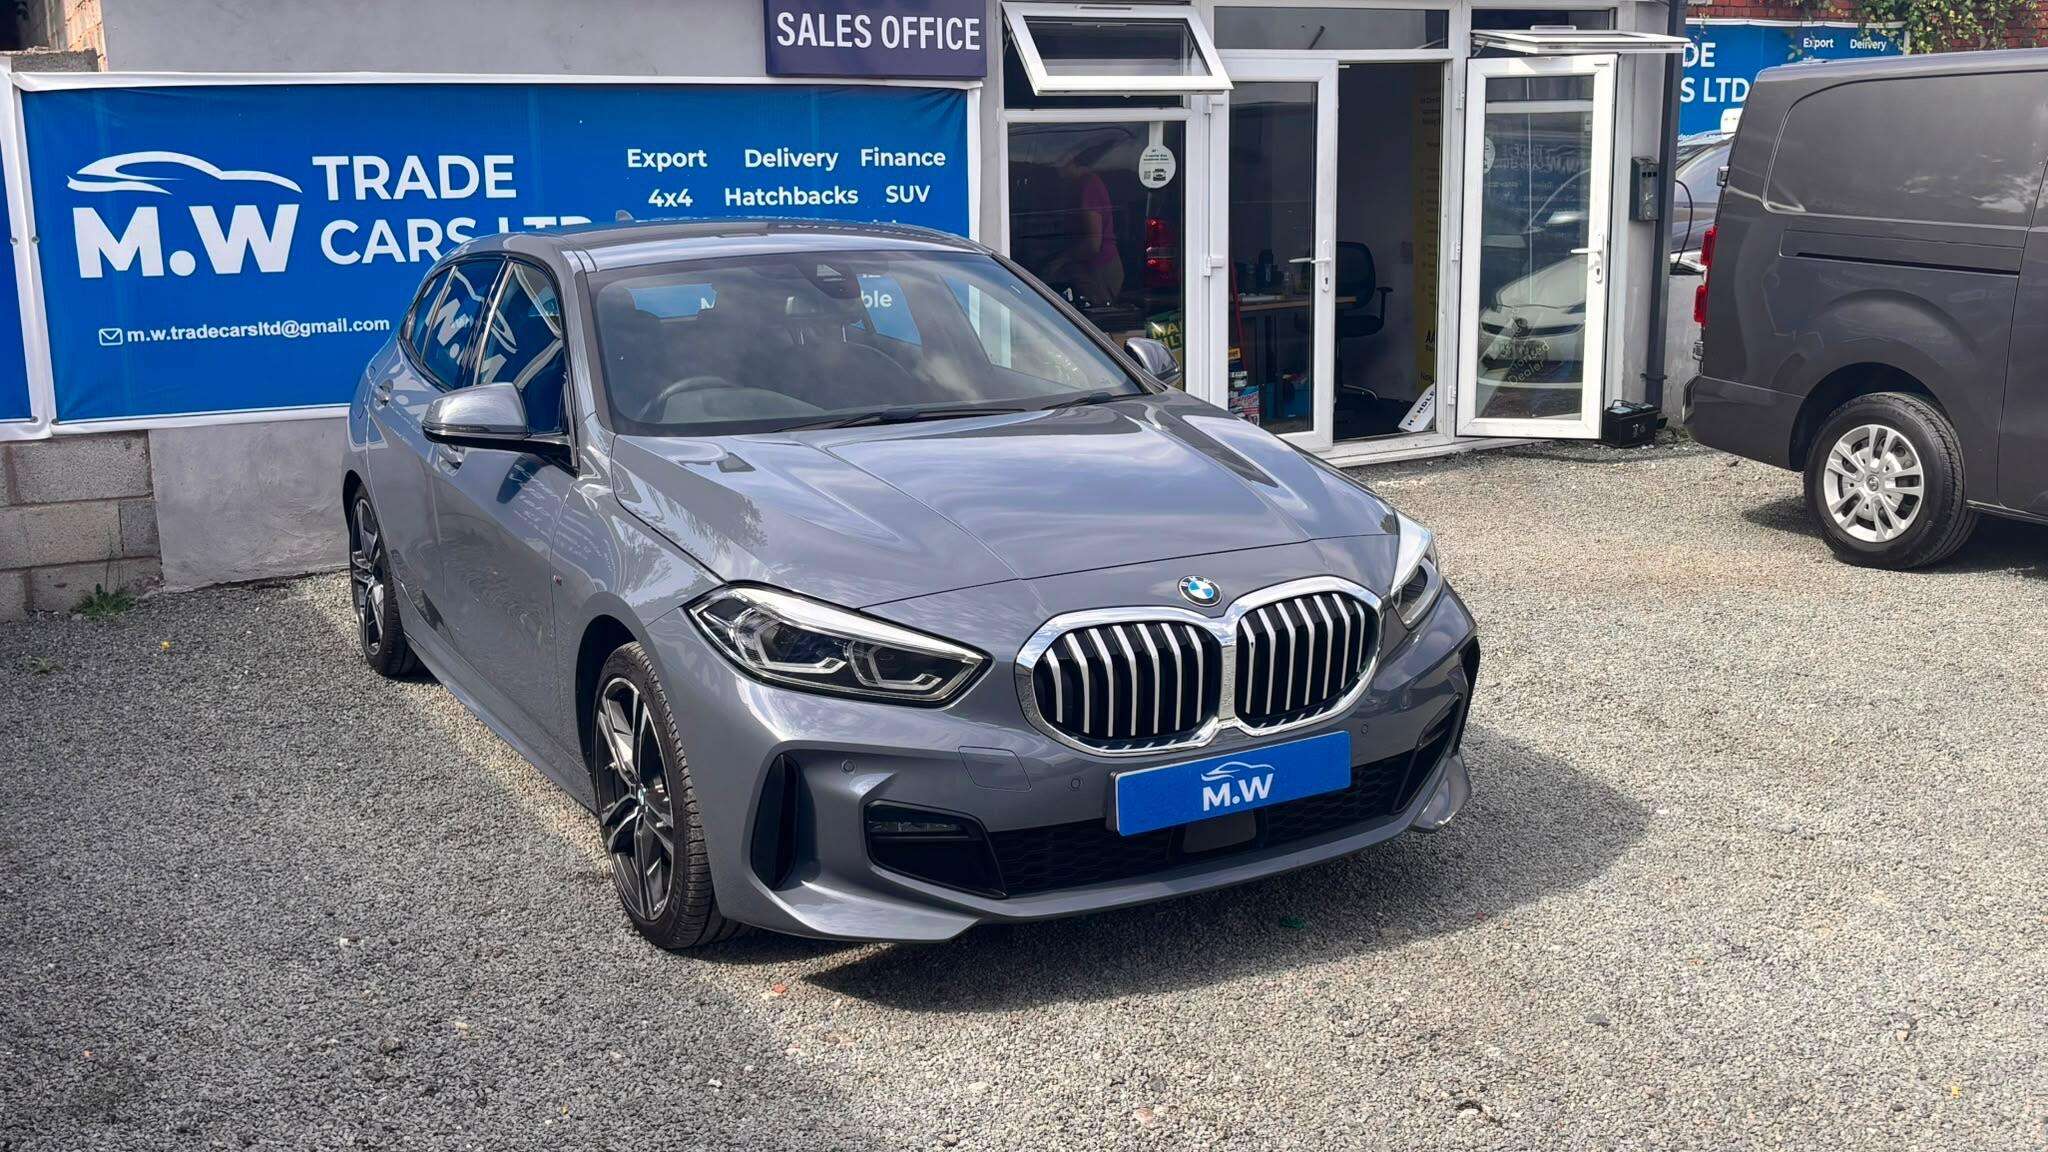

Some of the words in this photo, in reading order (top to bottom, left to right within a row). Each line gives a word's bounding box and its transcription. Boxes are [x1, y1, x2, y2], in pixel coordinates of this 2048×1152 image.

[776, 12, 872, 48] SALES
[881, 16, 981, 50] OFFICE
[1803, 38, 1834, 50] Export
[1850, 37, 1887, 52] Delivery
[1703, 77, 1750, 103] LTD
[627, 149, 708, 172] Export
[745, 148, 838, 172] Delivery
[861, 147, 946, 167] Finance
[312, 155, 517, 201] TRADE
[648, 188, 693, 208] 4x4
[725, 186, 859, 206] Hatchbacks
[885, 185, 931, 204] SUV
[73, 203, 300, 278] M.W
[127, 318, 390, 343] m.w.tradecarsltd@gmail.com
[1202, 773, 1274, 812] M.W
